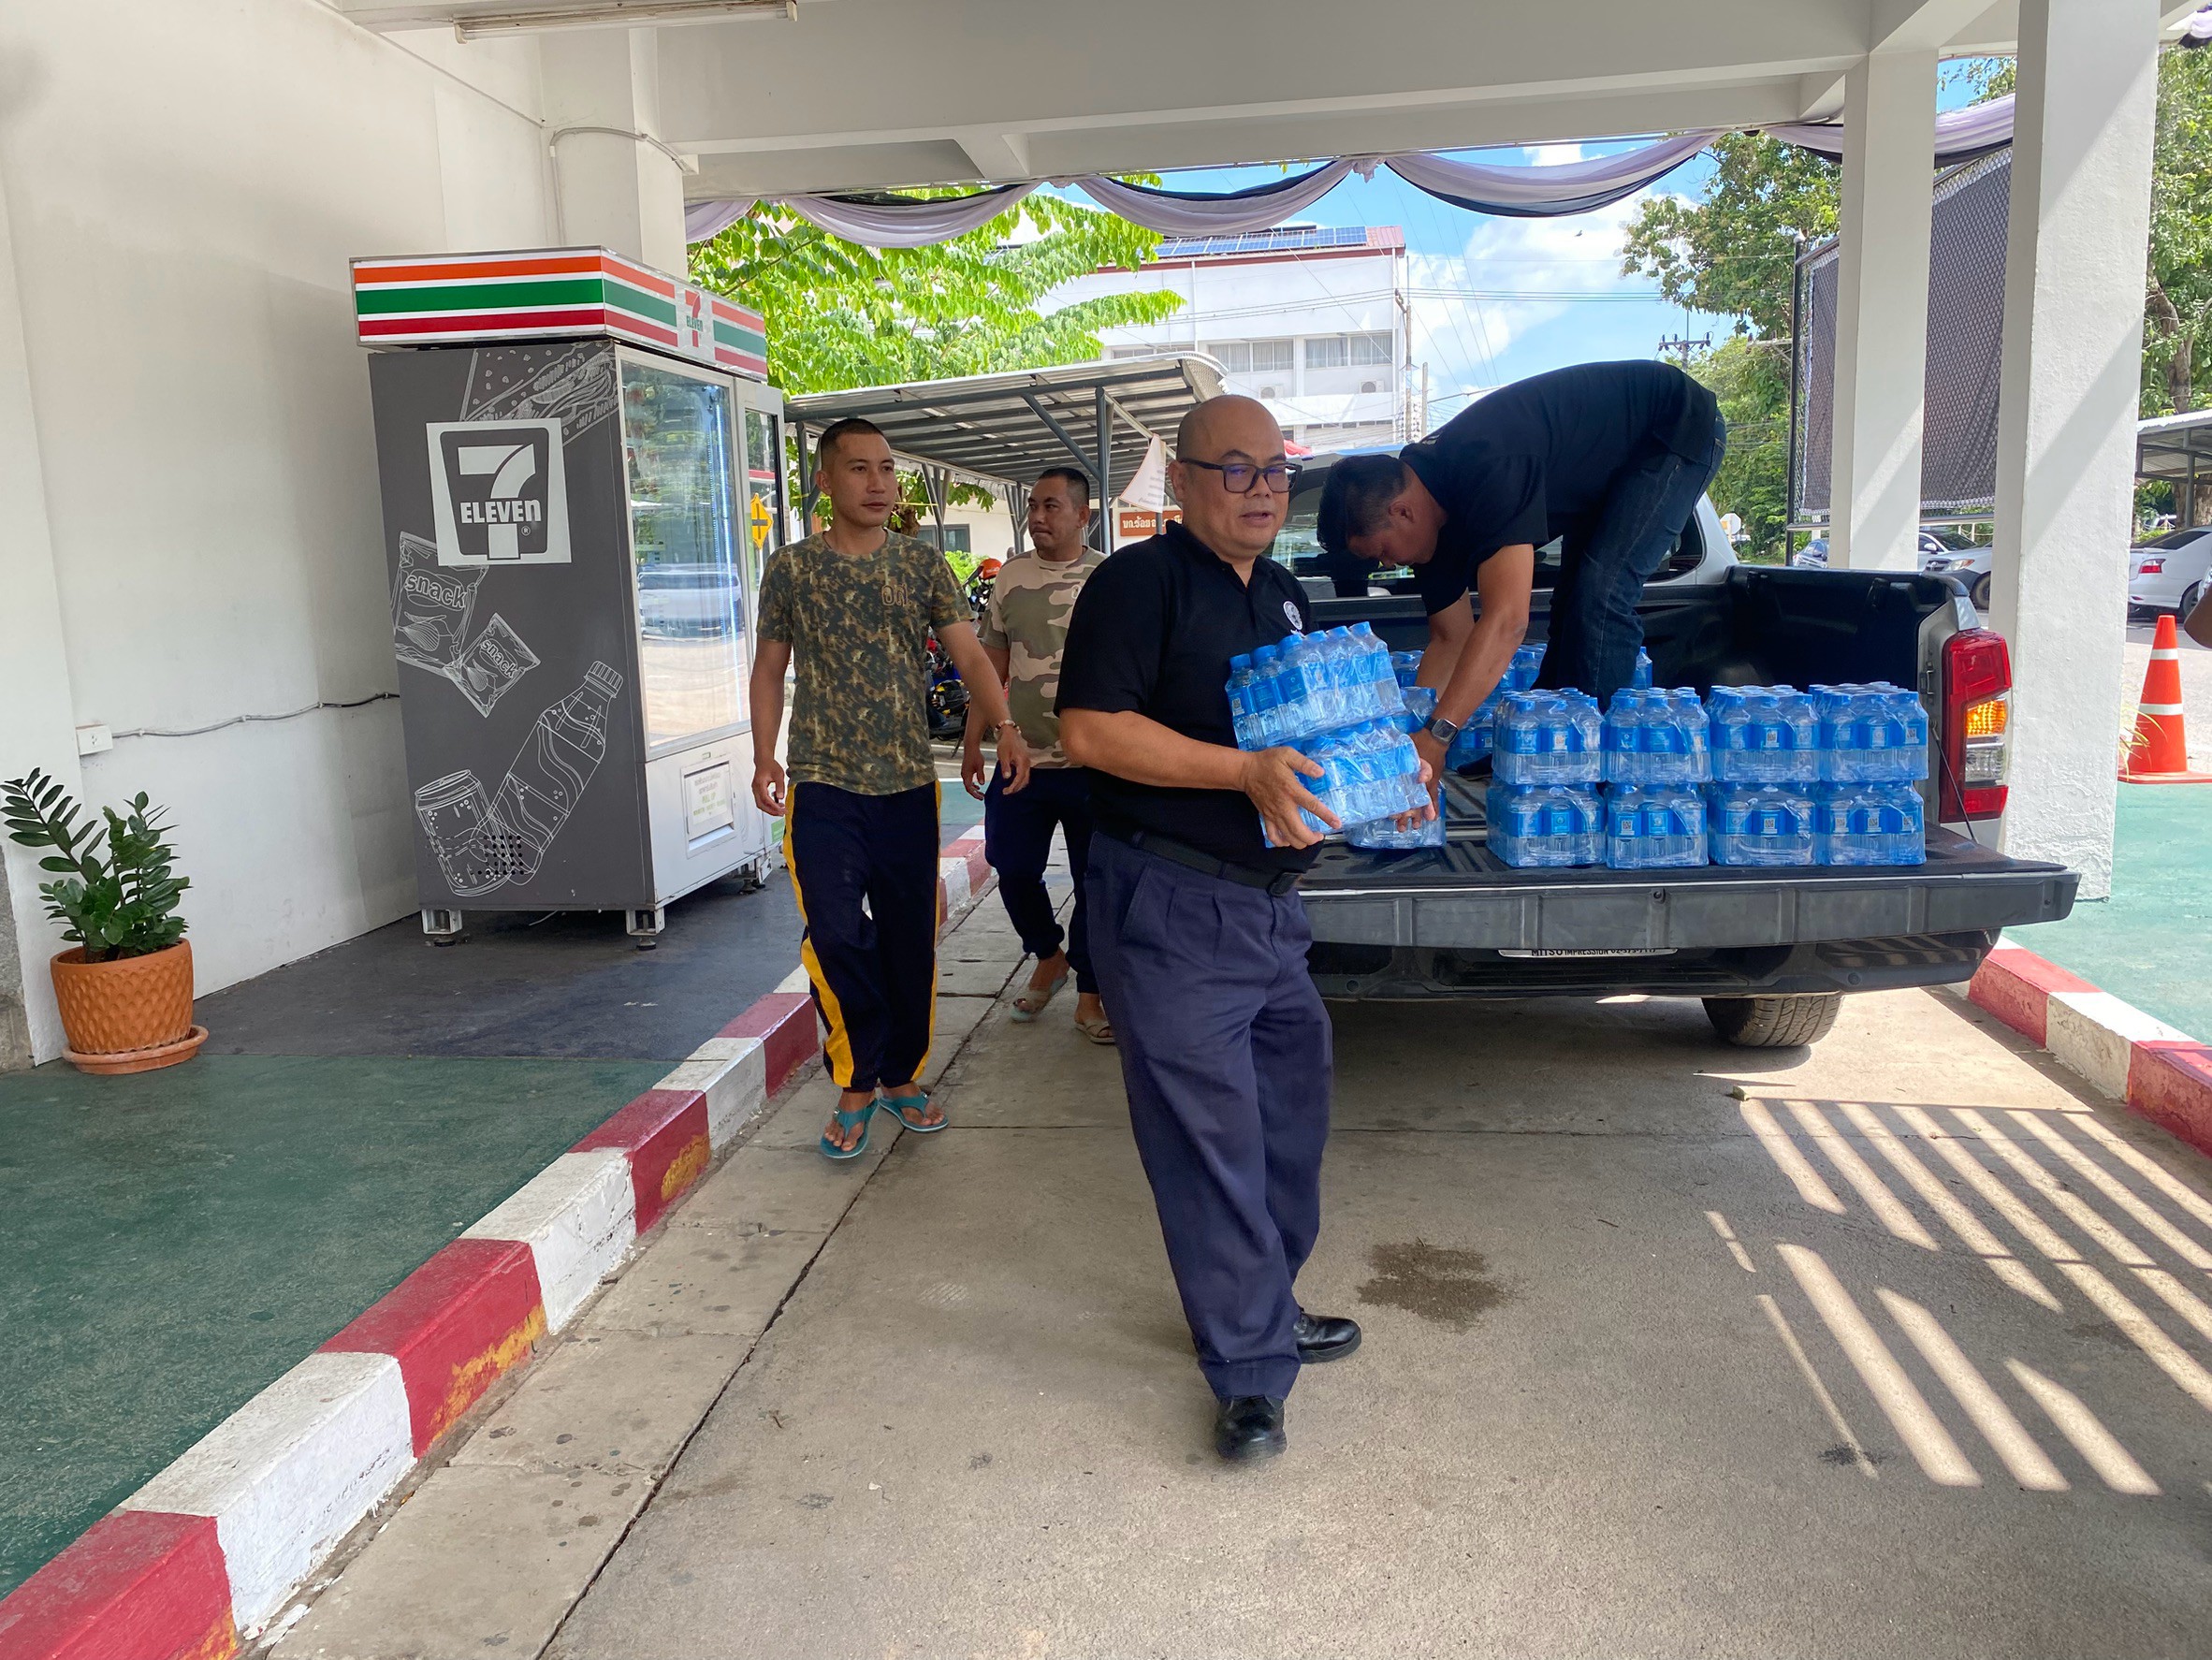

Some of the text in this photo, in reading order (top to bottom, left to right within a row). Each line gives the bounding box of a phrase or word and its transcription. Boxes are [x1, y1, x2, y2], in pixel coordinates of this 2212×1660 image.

[458, 444, 536, 559] 7
[404, 575, 468, 608] snack
[479, 639, 517, 678] snack
